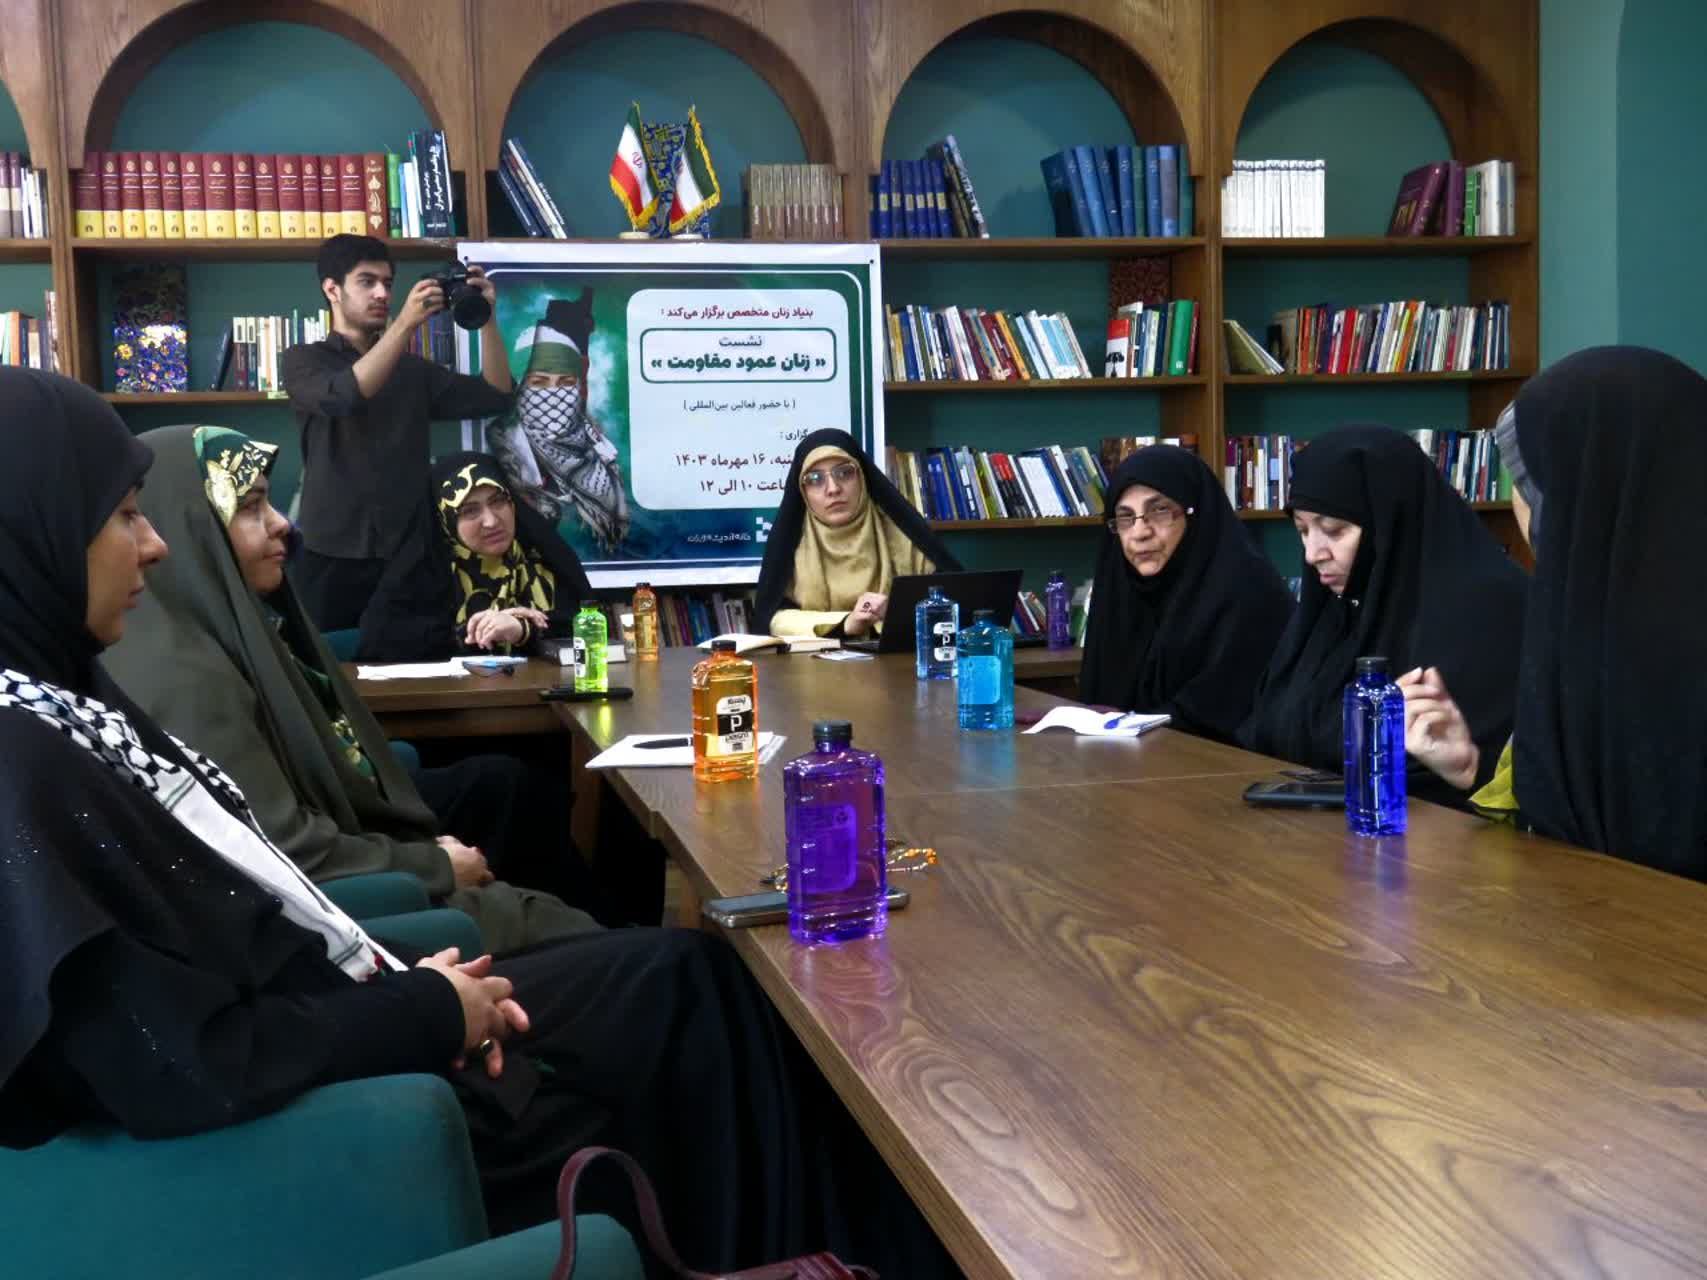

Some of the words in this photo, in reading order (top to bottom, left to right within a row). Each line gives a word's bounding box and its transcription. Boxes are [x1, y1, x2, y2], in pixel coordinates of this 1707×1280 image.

[701, 304, 725, 320] برگزار
[727, 306, 770, 320] متخصص
[772, 306, 790, 320] زنان
[792, 306, 813, 320] بنیاد
[718, 335, 762, 347] نشست
[667, 353, 731, 373] مقاومت
[736, 355, 776, 373] عمود
[781, 353, 810, 373] زنان
[785, 428, 809, 441] گزاری
[676, 453, 708, 466] ۱۴۰۳
[711, 454, 749, 470] مهرماه
[752, 453, 766, 465] ۱۶
[700, 480, 714, 492] ۱۲
[718, 479, 737, 496] الی
[757, 478, 785, 492] اعت
